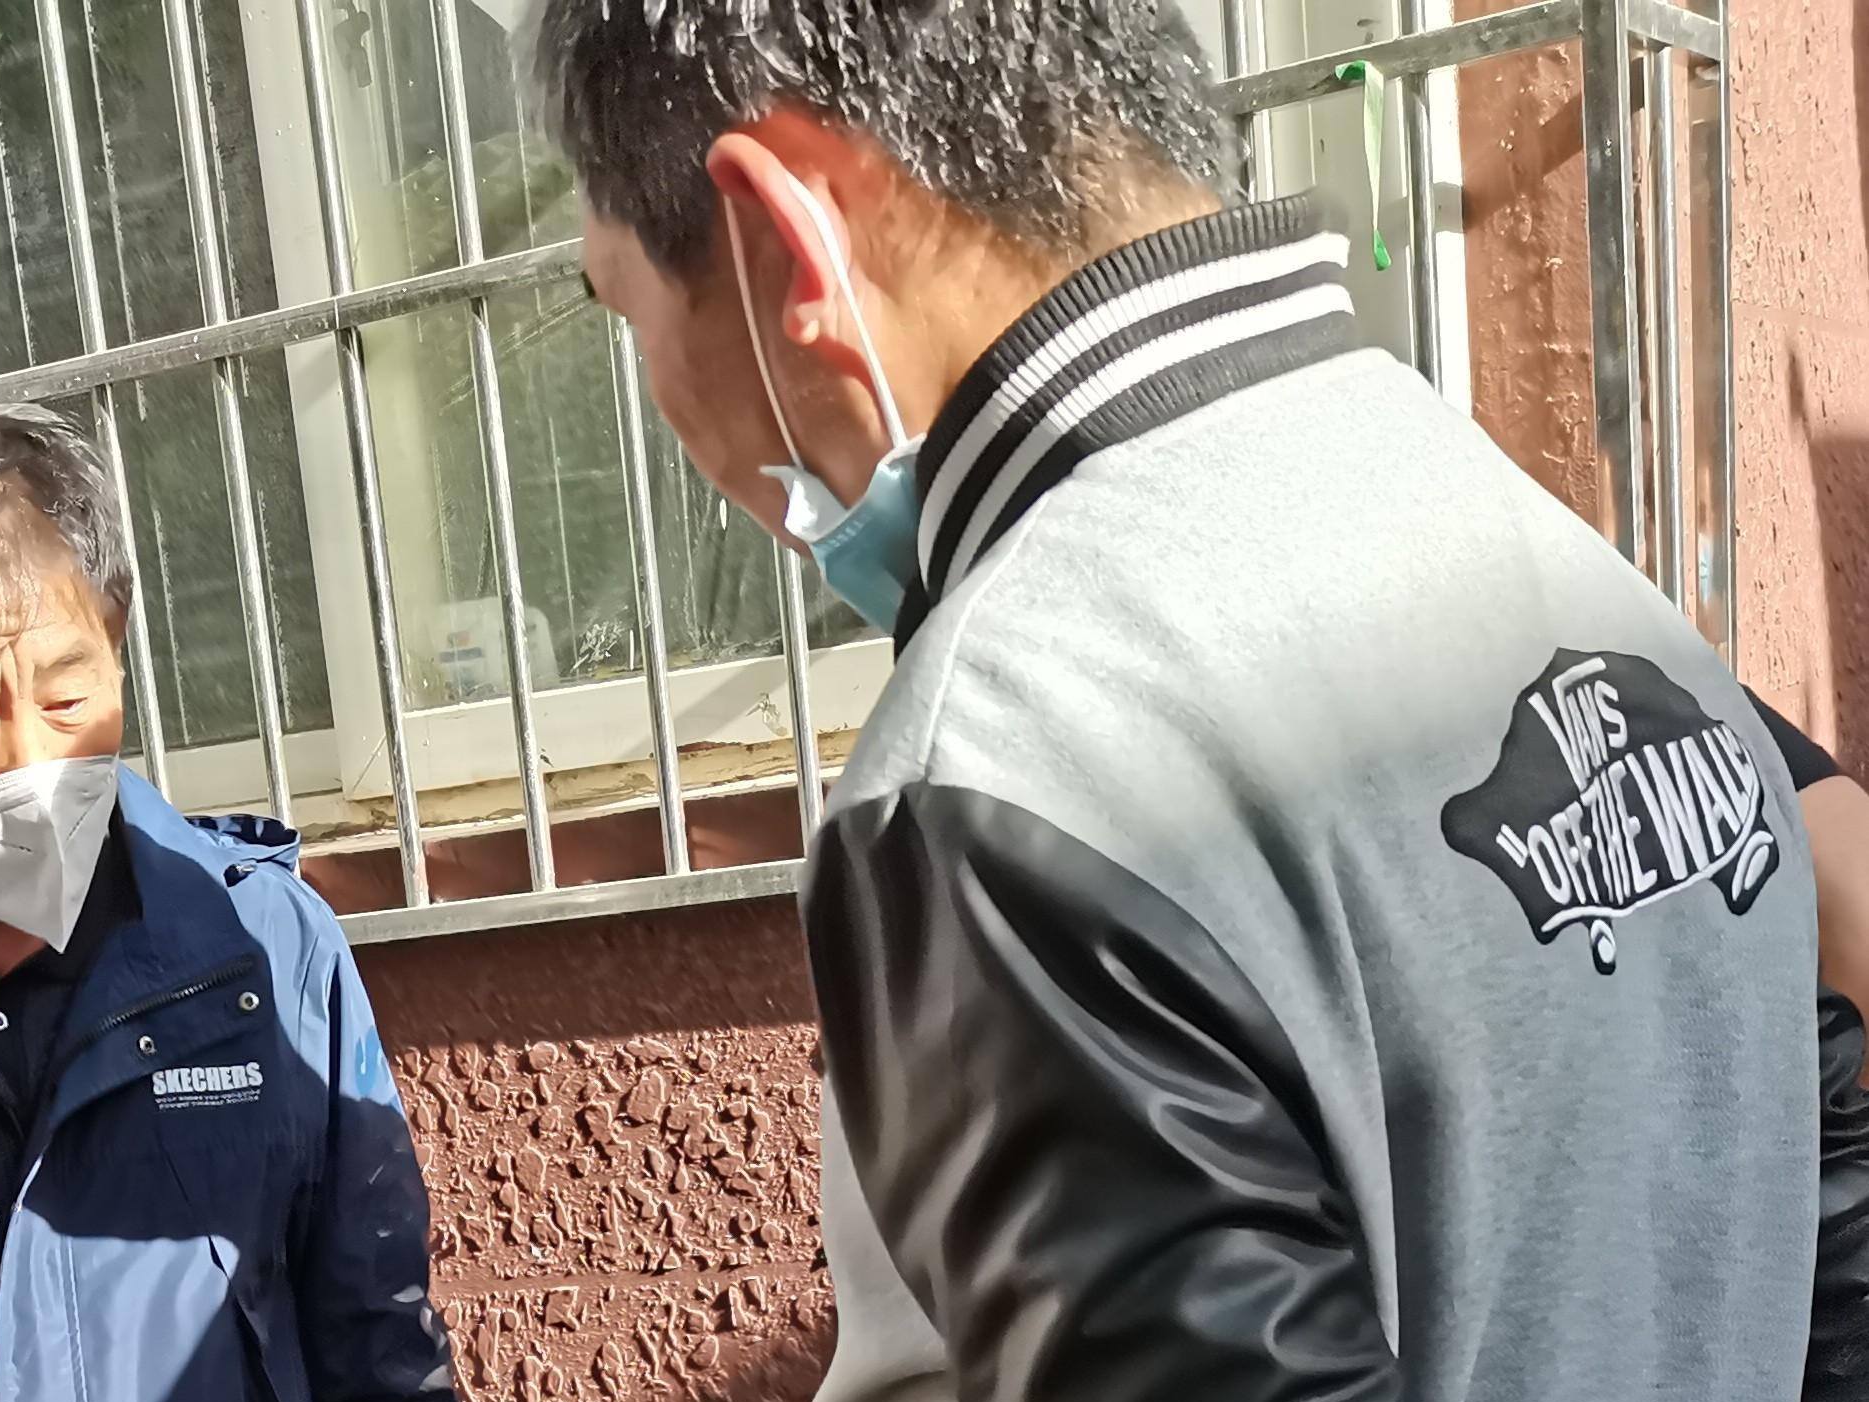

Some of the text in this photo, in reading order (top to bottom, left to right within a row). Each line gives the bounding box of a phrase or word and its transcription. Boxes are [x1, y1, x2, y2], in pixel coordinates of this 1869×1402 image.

[1527, 656, 1628, 791] VANS
[1580, 759, 1658, 905] THE
[152, 1061, 263, 1095] SKECHERS
